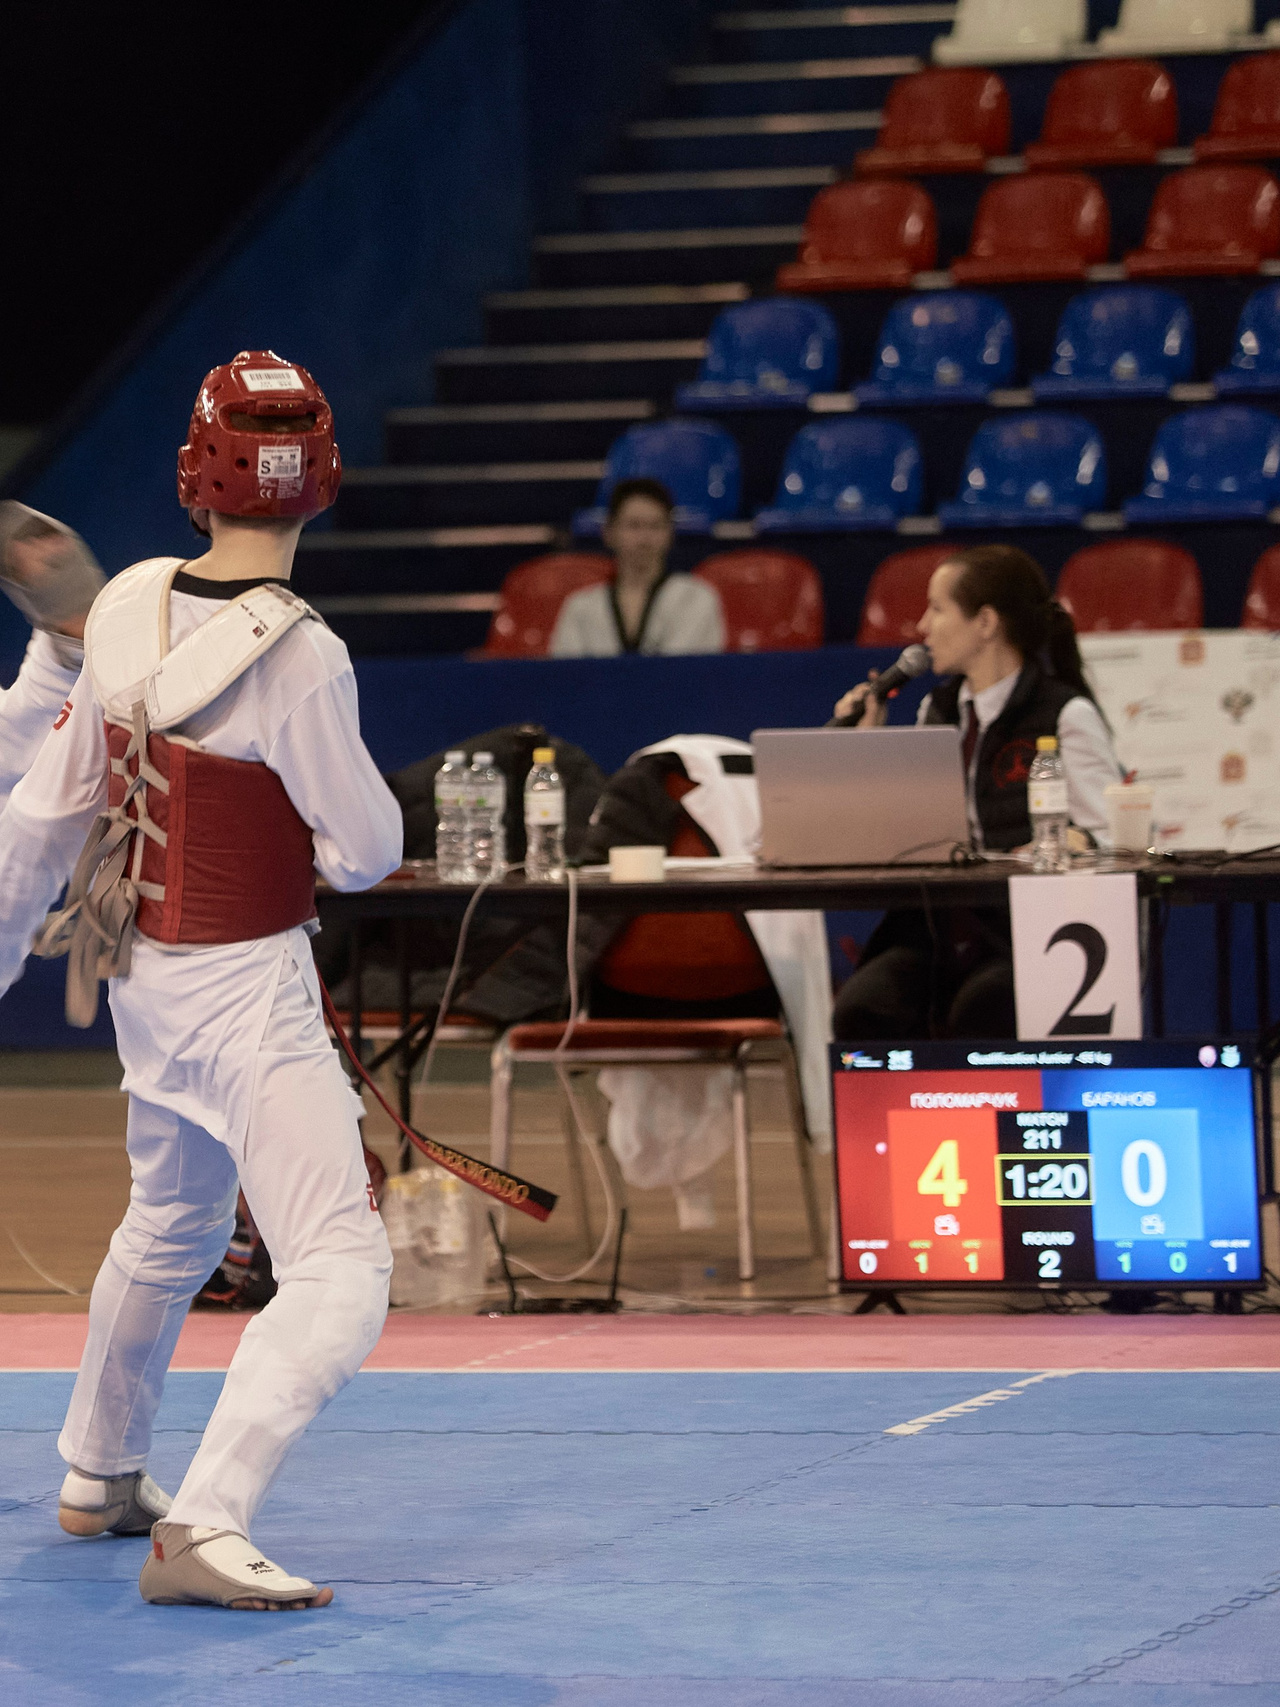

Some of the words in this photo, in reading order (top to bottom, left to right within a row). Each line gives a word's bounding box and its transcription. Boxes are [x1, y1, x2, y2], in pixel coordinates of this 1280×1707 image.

[261, 461, 271, 474] S
[1044, 922, 1116, 1036] 2
[1017, 1112, 1069, 1127] MATCH
[1023, 1129, 1061, 1150] 211
[917, 1140, 968, 1207] 4
[1005, 1163, 1088, 1199] 1:20
[1121, 1139, 1167, 1207] 0
[1022, 1231, 1075, 1246] ROUND
[859, 1252, 878, 1274] 0
[914, 1252, 928, 1274] 1
[964, 1252, 978, 1274] 1
[1038, 1250, 1062, 1278] 2
[1117, 1252, 1131, 1273] 1
[1170, 1252, 1187, 1273] 0
[1223, 1252, 1237, 1273] 1
